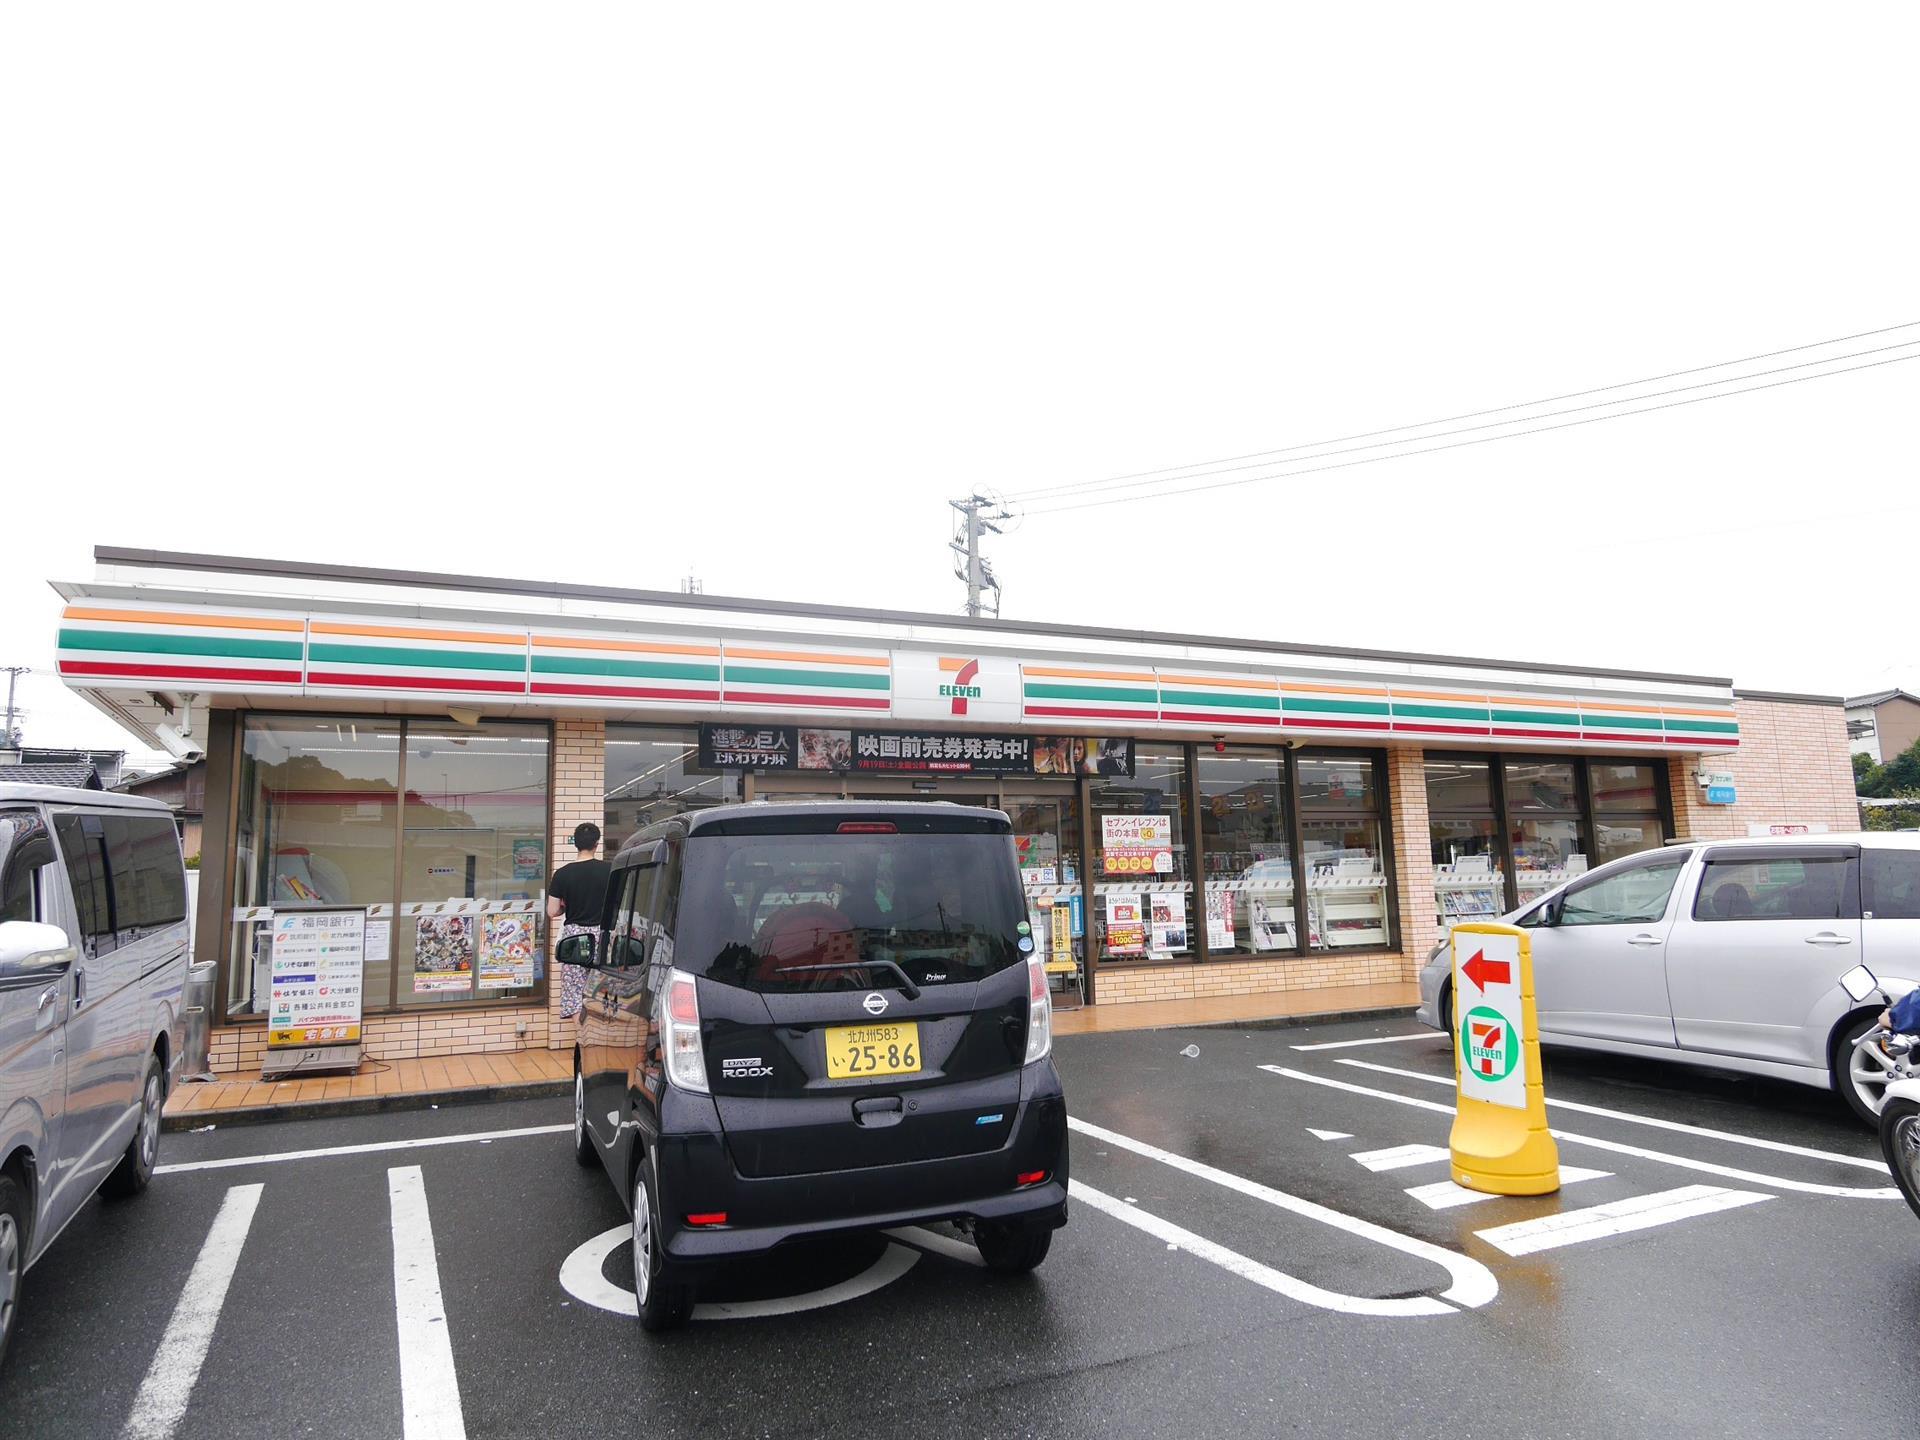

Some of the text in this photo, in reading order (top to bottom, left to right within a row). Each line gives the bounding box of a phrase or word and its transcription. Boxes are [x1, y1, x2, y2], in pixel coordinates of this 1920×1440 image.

[939, 656, 978, 715] 7
[712, 729, 789, 749] 進撃の巨人
[857, 735, 1029, 760] 映画前売券発売中!
[1106, 828, 1139, 838] 街の本屋
[302, 916, 355, 928] 福岡銀行
[294, 1001, 355, 1010] 各種公共料金窓口
[304, 1028, 347, 1040] 宅急便
[1472, 1023, 1501, 1075] 7
[832, 1043, 916, 1073] い 25-86
[722, 1067, 774, 1079] ROOX
